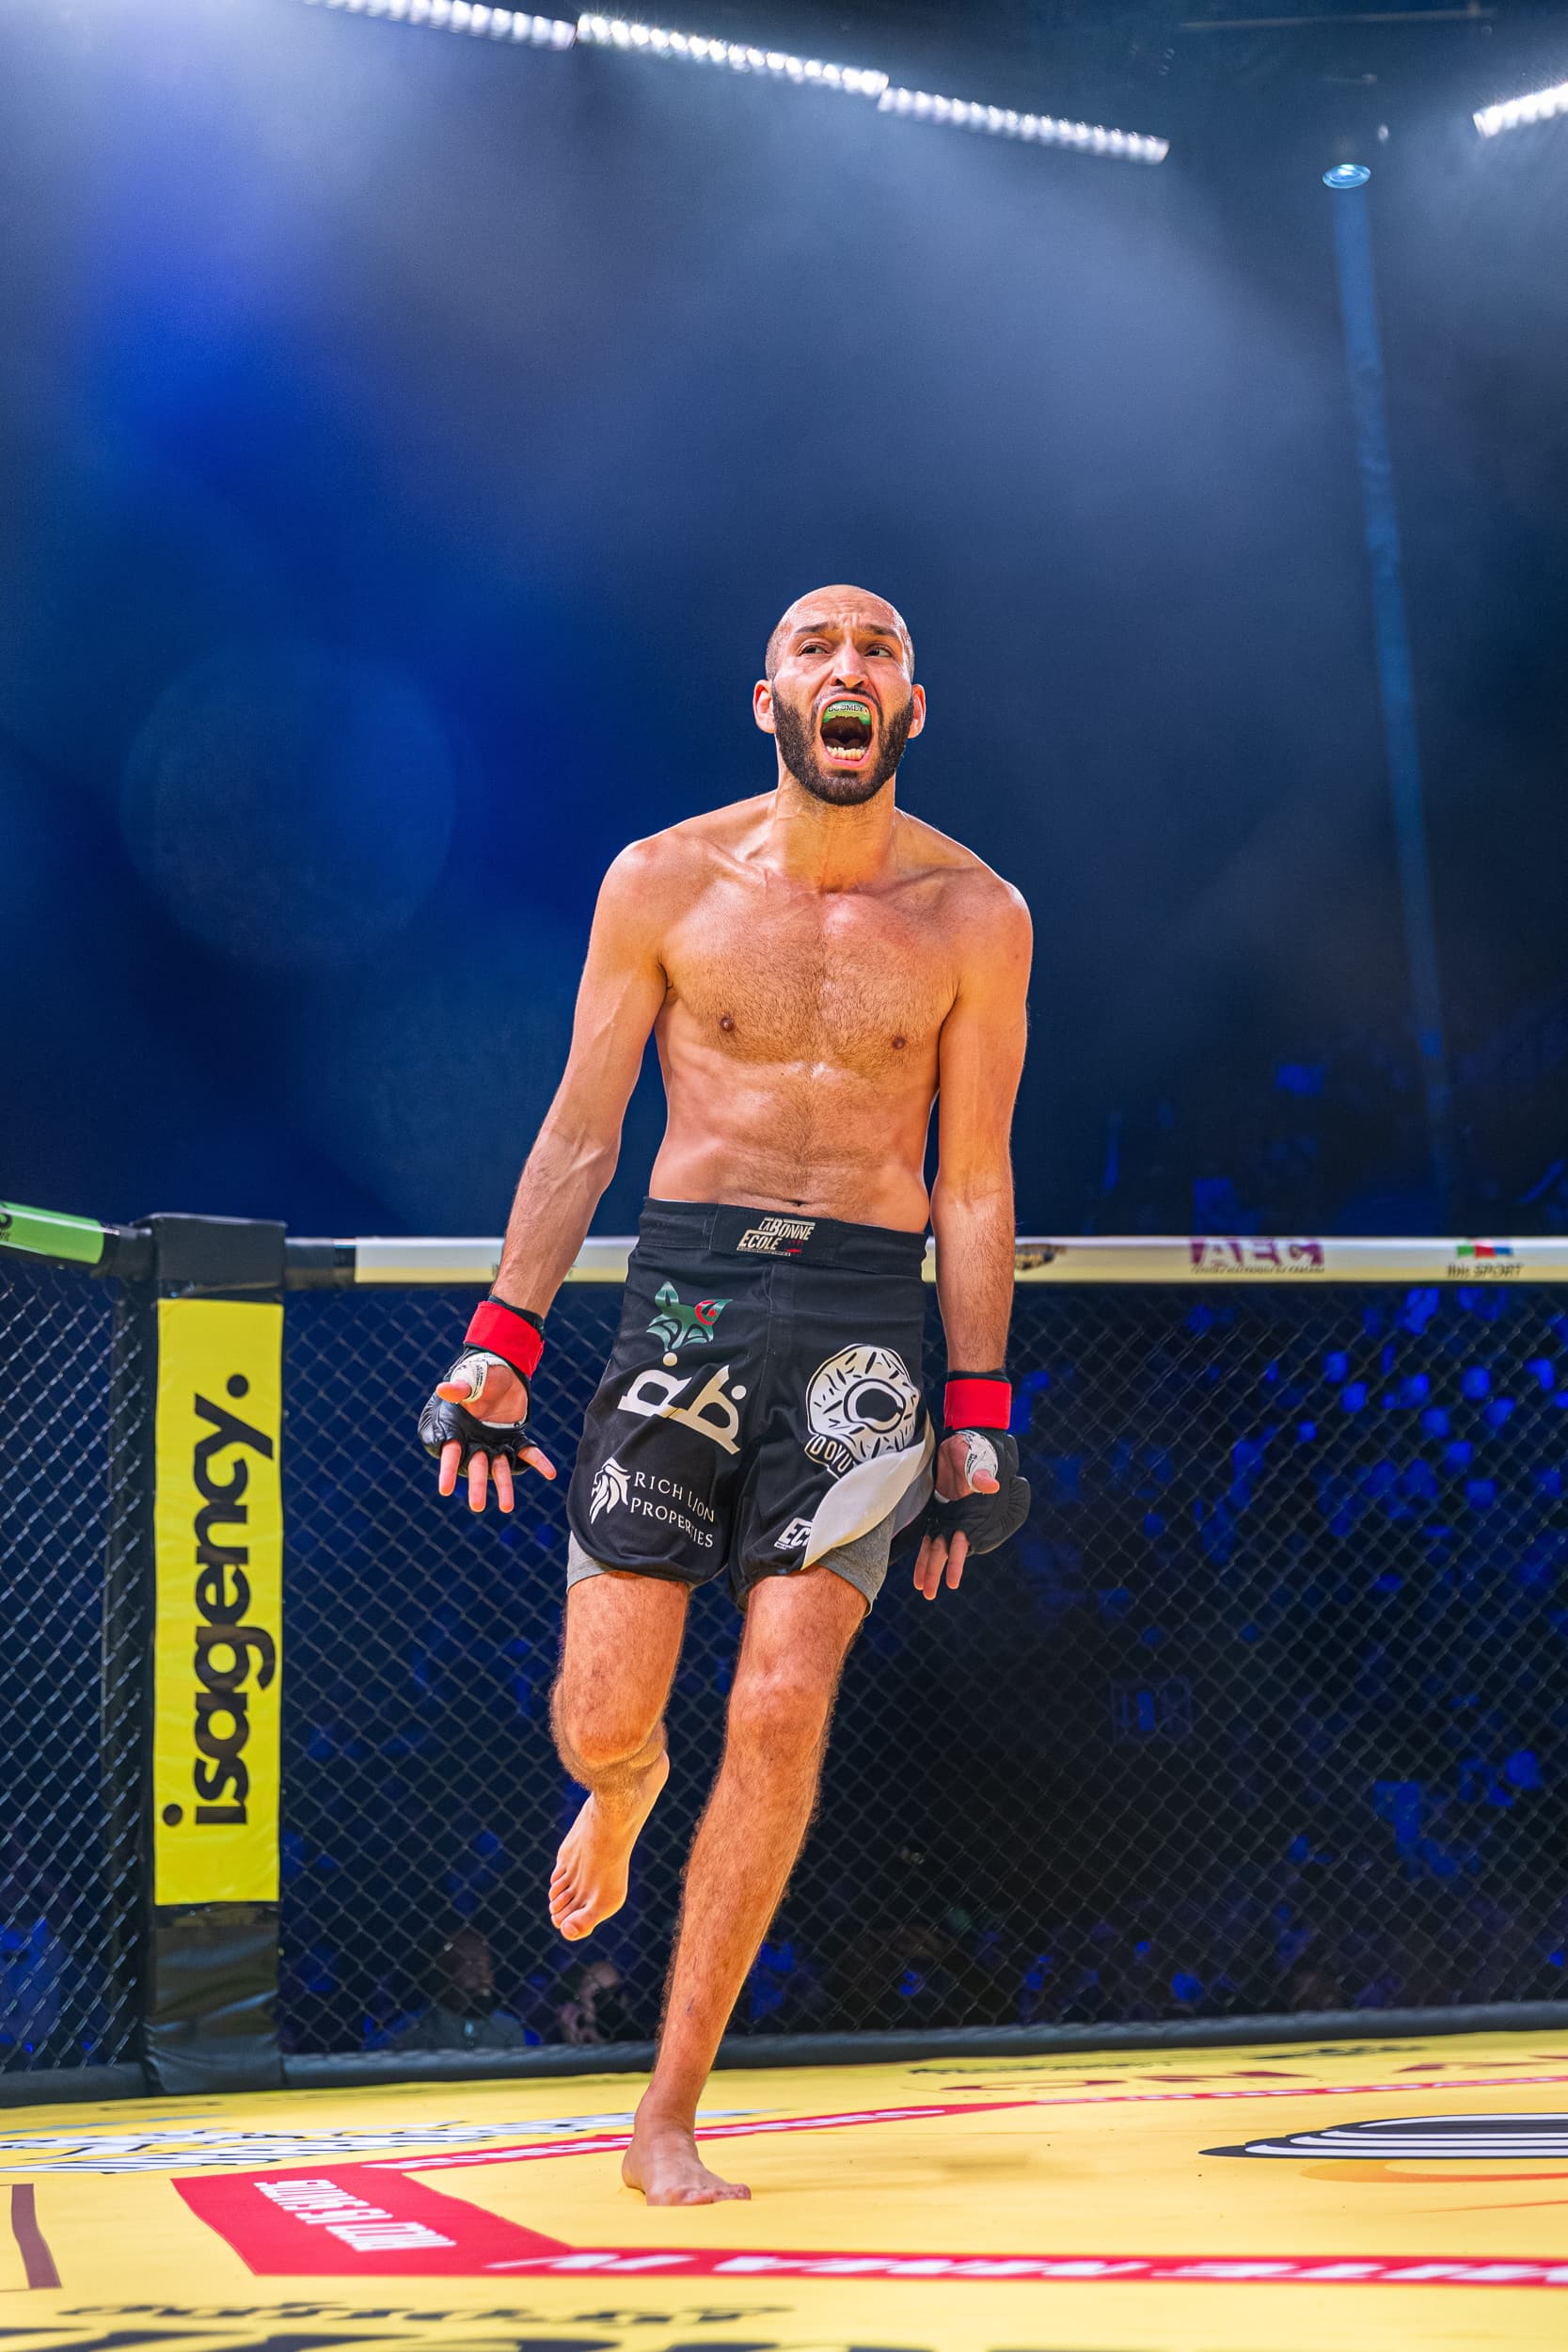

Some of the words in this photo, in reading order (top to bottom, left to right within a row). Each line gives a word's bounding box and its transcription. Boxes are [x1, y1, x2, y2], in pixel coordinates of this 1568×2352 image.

[737, 1229, 783, 1251] ECOLE
[769, 1216, 815, 1241] BONNE
[809, 1435, 857, 1473] DOYU
[634, 1471, 683, 1501] RICH
[688, 1490, 715, 1523] LION
[630, 1498, 714, 1548] PROPERTIES
[162, 1374, 276, 1827] isagency.
